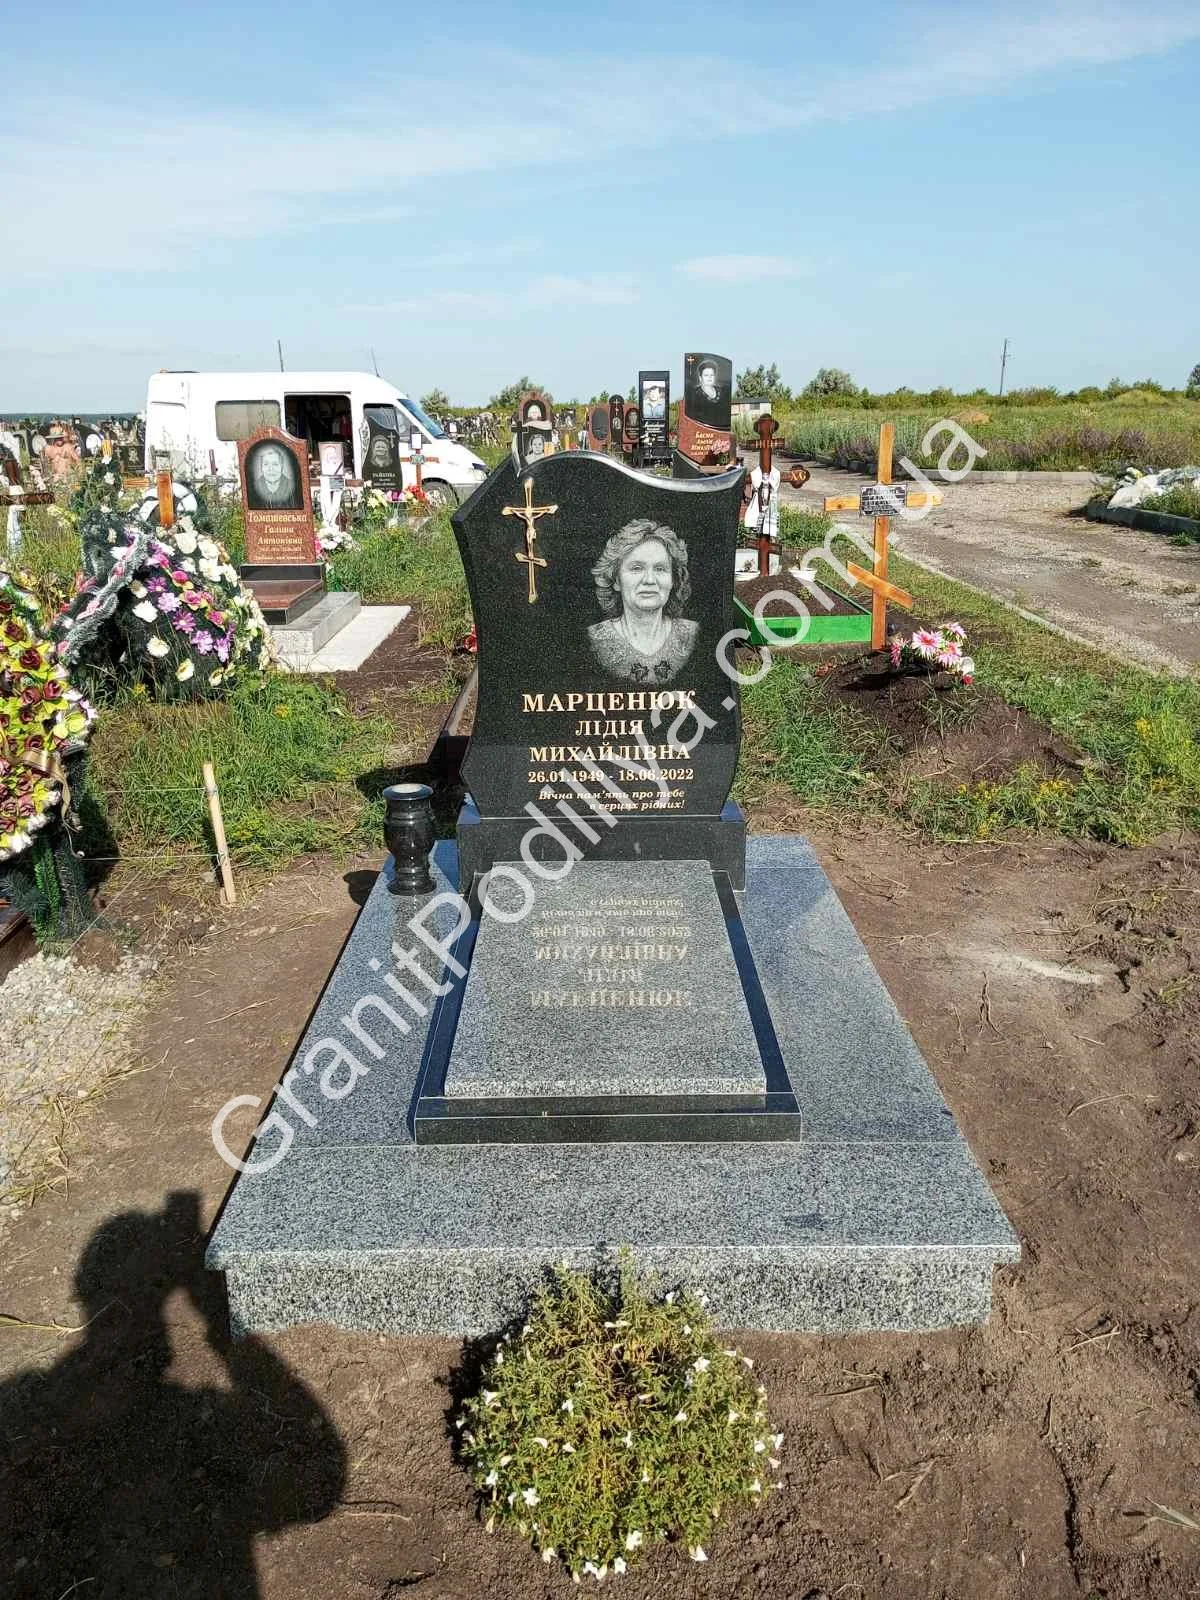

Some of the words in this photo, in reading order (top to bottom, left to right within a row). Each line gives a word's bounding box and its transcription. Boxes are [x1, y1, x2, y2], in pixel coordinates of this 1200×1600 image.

[247, 512, 307, 522] Томашевська
[522, 690, 696, 715] МАРЦЕНЮК
[575, 720, 644, 739] ЛІДІЯ
[529, 742, 692, 762] МИХАЙЛІВНА
[528, 770, 604, 783] 26.01.1949
[619, 768, 694, 782] 18.06.2022
[538, 790, 573, 800] Вічна
[632, 791, 654, 801] про
[656, 789, 686, 799] тебе
[598, 802, 639, 812] серцях
[641, 799, 686, 811] рідних!
